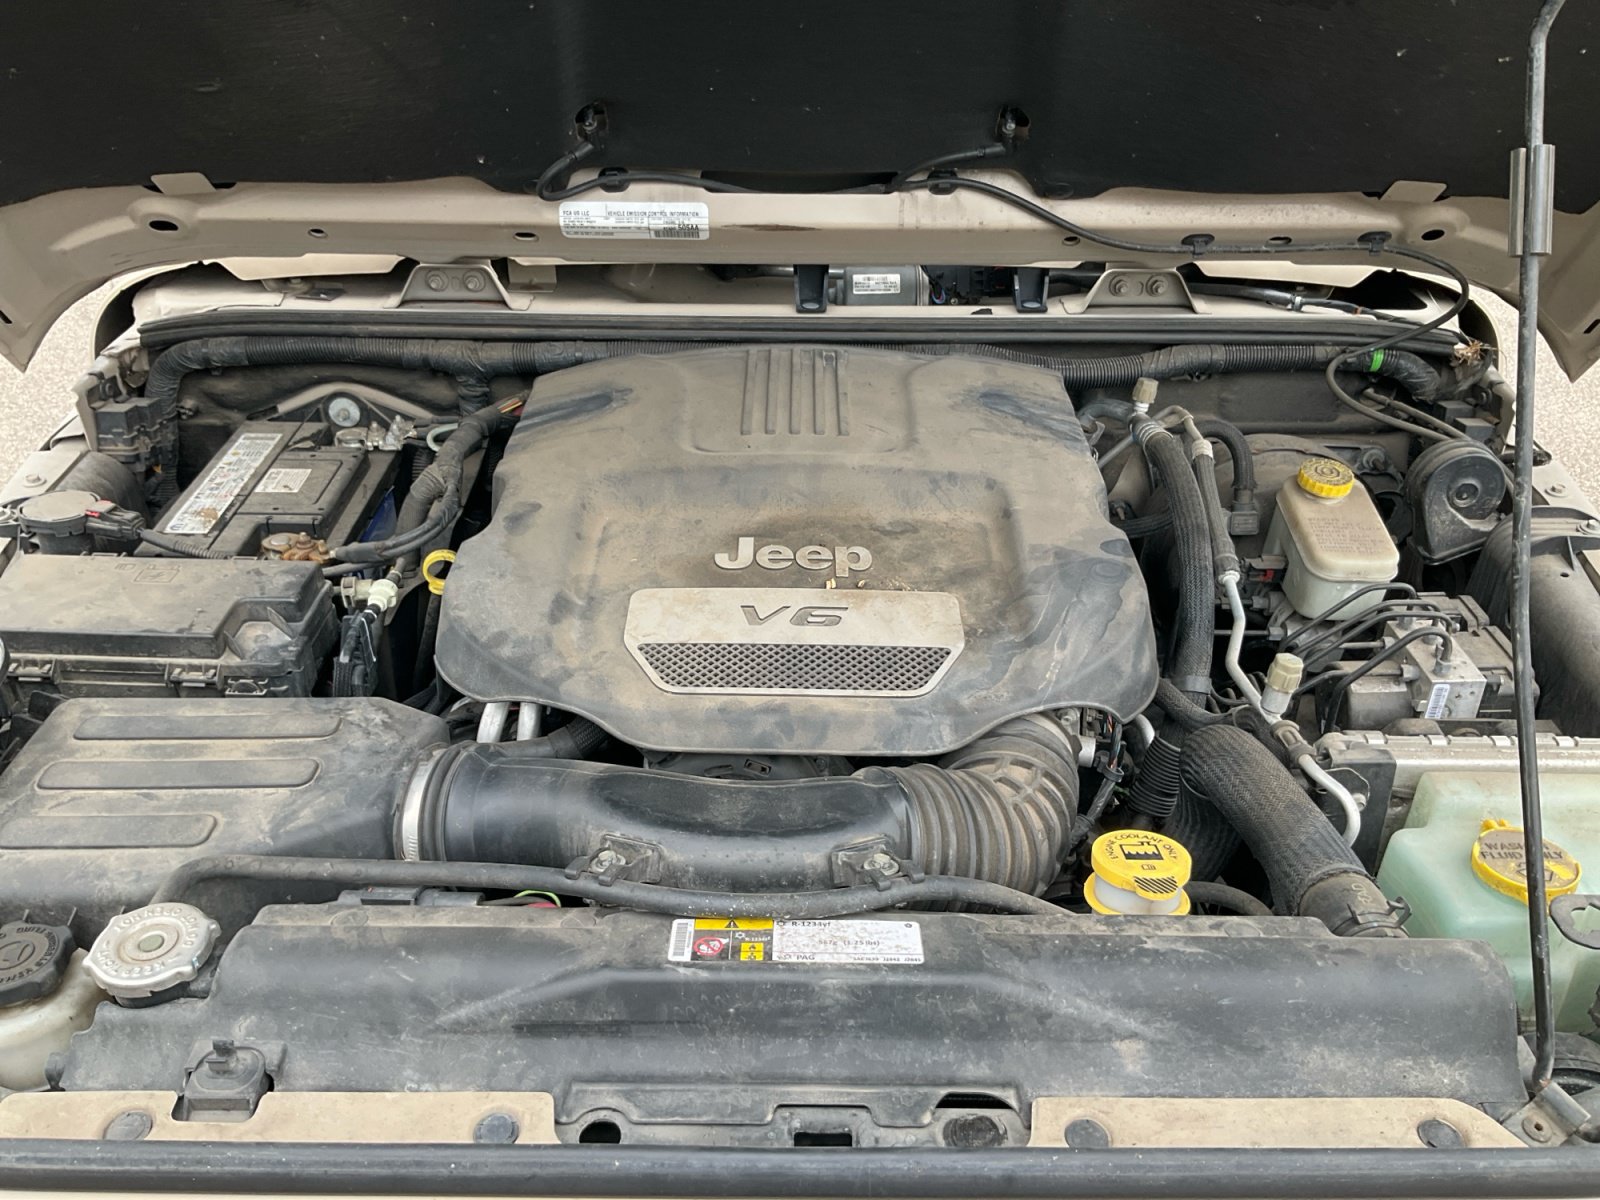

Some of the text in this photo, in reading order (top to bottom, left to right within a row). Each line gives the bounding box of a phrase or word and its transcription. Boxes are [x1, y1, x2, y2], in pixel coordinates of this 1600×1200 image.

[714, 537, 873, 577] Jeep
[740, 605, 849, 626] V6
[1105, 833, 1178, 860] ENGINE COOLANT ONLY
[1480, 851, 1523, 860] FLUID
[144, 906, 182, 918] OPEN
[121, 961, 165, 978] KEEP
